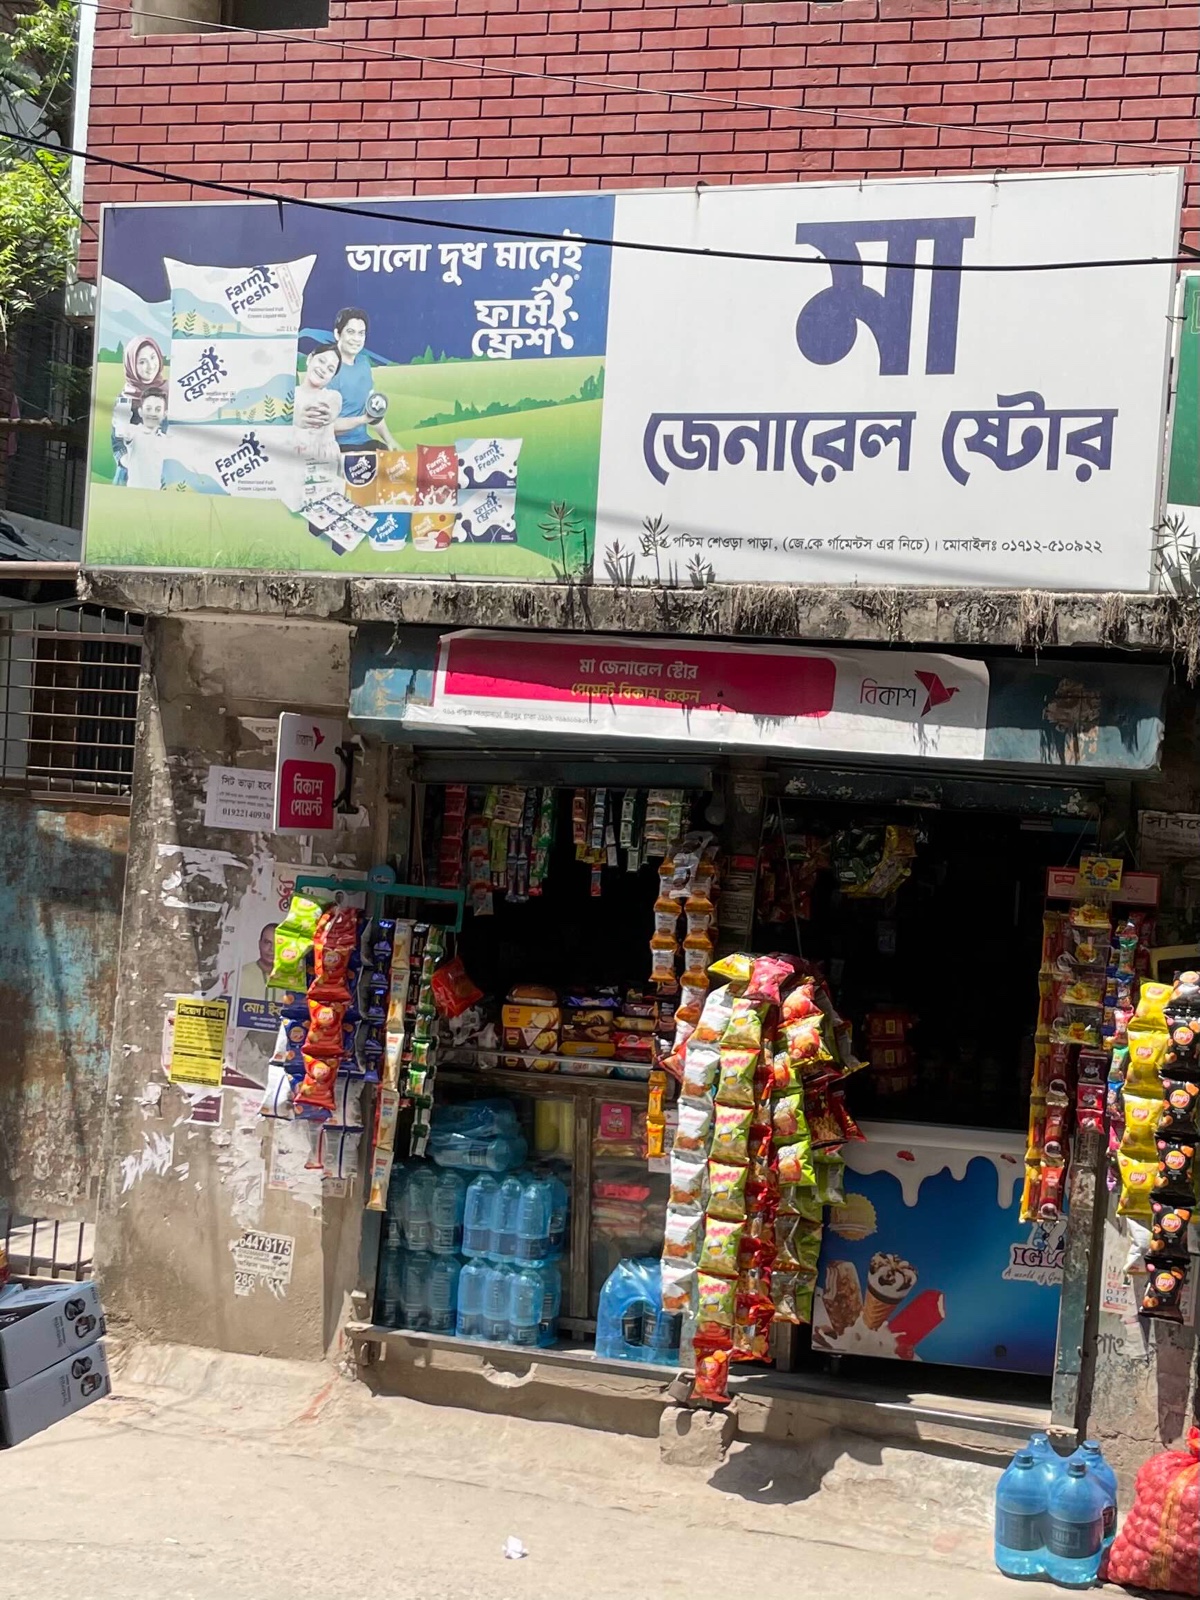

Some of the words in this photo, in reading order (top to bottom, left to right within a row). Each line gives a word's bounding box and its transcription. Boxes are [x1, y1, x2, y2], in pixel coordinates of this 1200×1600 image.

[346, 243, 432, 273] ভালো
[438, 242, 487, 286] দুধ
[494, 228, 587, 272] মানেই
[225, 272, 262, 300] Farm
[231, 284, 271, 314] Fresh
[795, 216, 976, 376] মা
[474, 290, 551, 328] ফার্ম
[471, 328, 556, 359] ফ্রেশ
[177, 360, 213, 388] ফার্ম
[184, 372, 220, 402] ফ্রেশ
[642, 411, 917, 487] জেনারেল
[941, 390, 1119, 487] ষ্টোর
[215, 444, 251, 473] Farm
[474, 448, 494, 464] Farm
[477, 454, 500, 471] Fresh
[221, 457, 261, 487] Fresh
[672, 533, 704, 549] পশ্চিম
[707, 537, 743, 550] শেওড়া
[747, 537, 778, 551] পাড়া,
[876, 538, 894, 551] এর
[898, 535, 930, 554] নিচে)
[1001, 539, 1103, 554] ০১৭১২-৫১০৯২২
[579, 658, 597, 674] মা
[600, 660, 663, 677] জেনারেল
[570, 681, 616, 698] পেমেন্ট
[618, 682, 660, 701] বিকাশ
[664, 689, 701, 704] করুন
[860, 678, 916, 707] বিকাশ
[221, 774, 236, 787] সিট
[237, 778, 256, 791] ভাড়া
[258, 780, 272, 791] হবে
[293, 772, 323, 795] বিকাশ
[222, 807, 271, 821] 01922140930
[291, 798, 323, 817] পেমেন্ট
[243, 1002, 265, 1014] মোঃ
[1014, 1270, 1034, 1279] world
